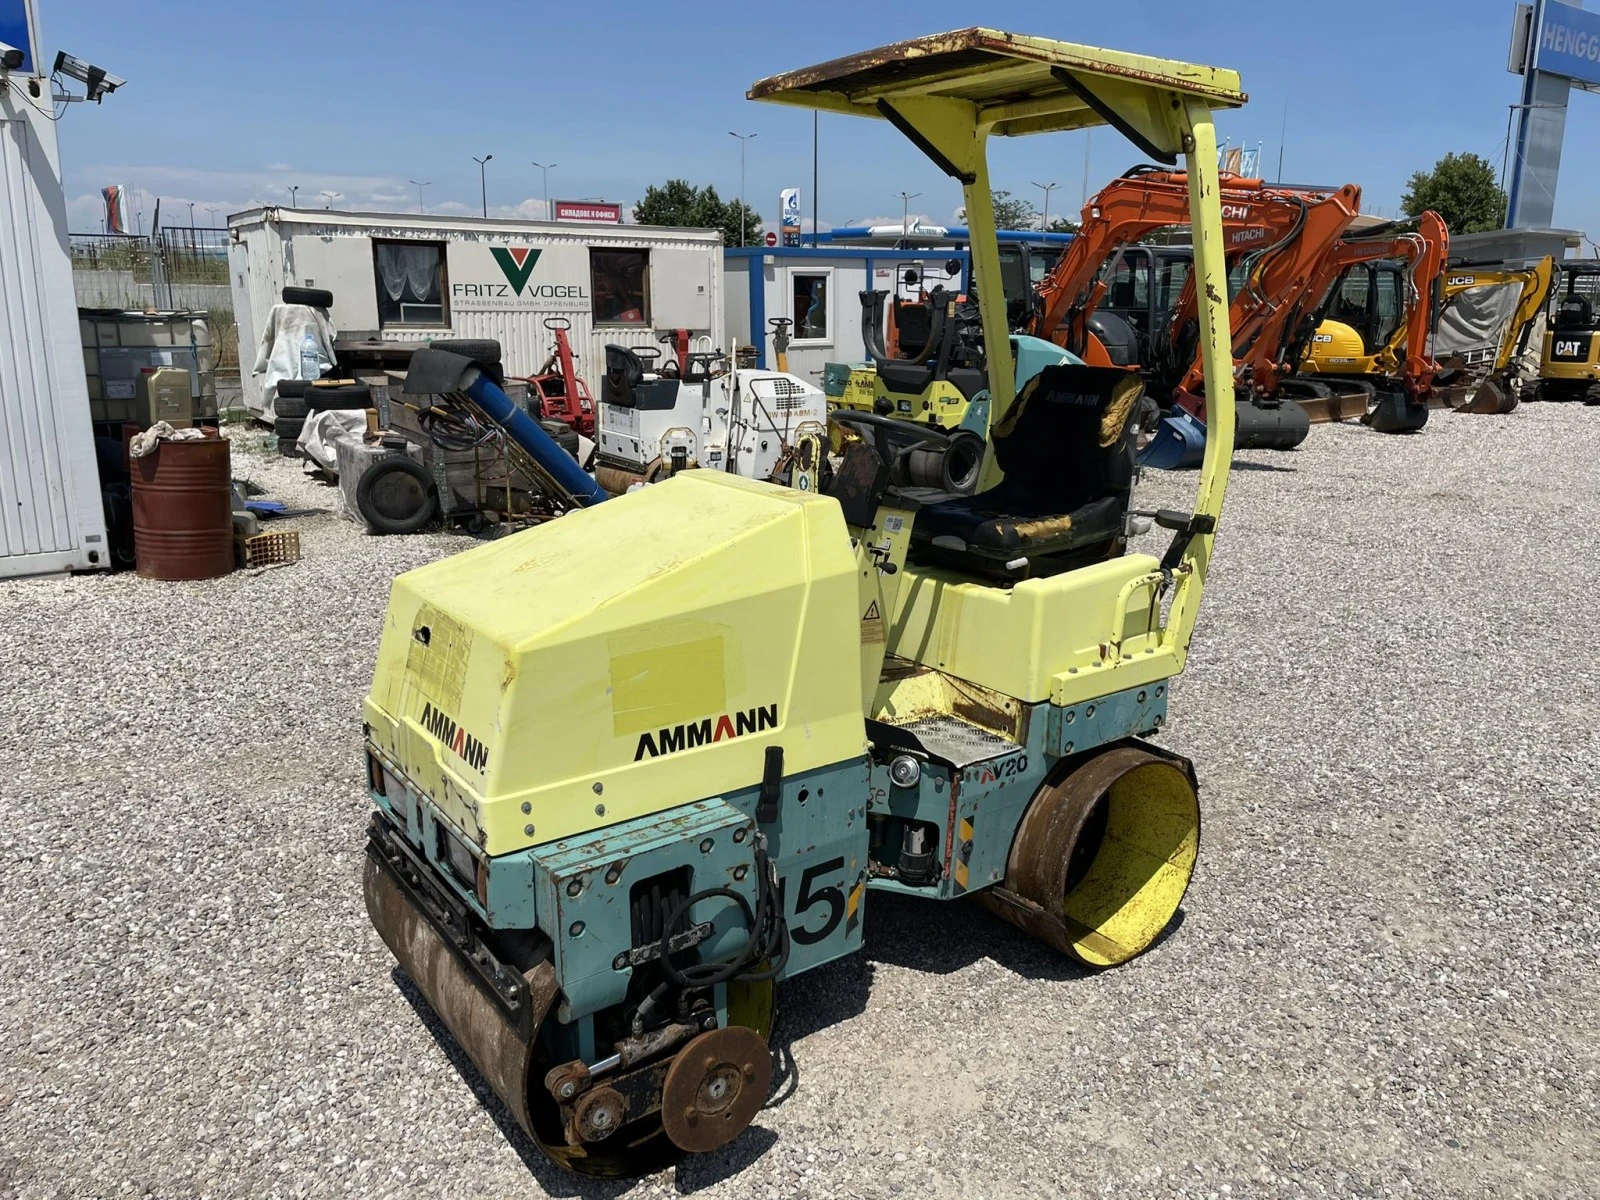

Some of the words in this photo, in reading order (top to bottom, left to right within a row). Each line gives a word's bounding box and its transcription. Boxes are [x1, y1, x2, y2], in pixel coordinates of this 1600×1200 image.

[1542, 21, 1600, 63] HENGG
[1231, 227, 1265, 243] HITACHI
[1447, 276, 1474, 286] JCB
[453, 283, 509, 297] FRITZ
[528, 285, 589, 298] VOGEL
[453, 299, 515, 307] STRASSENBAU
[543, 300, 590, 308] OFFENBURG
[1555, 340, 1581, 356] CAT
[420, 701, 489, 776] AMMANN
[633, 703, 778, 762] AMMANN
